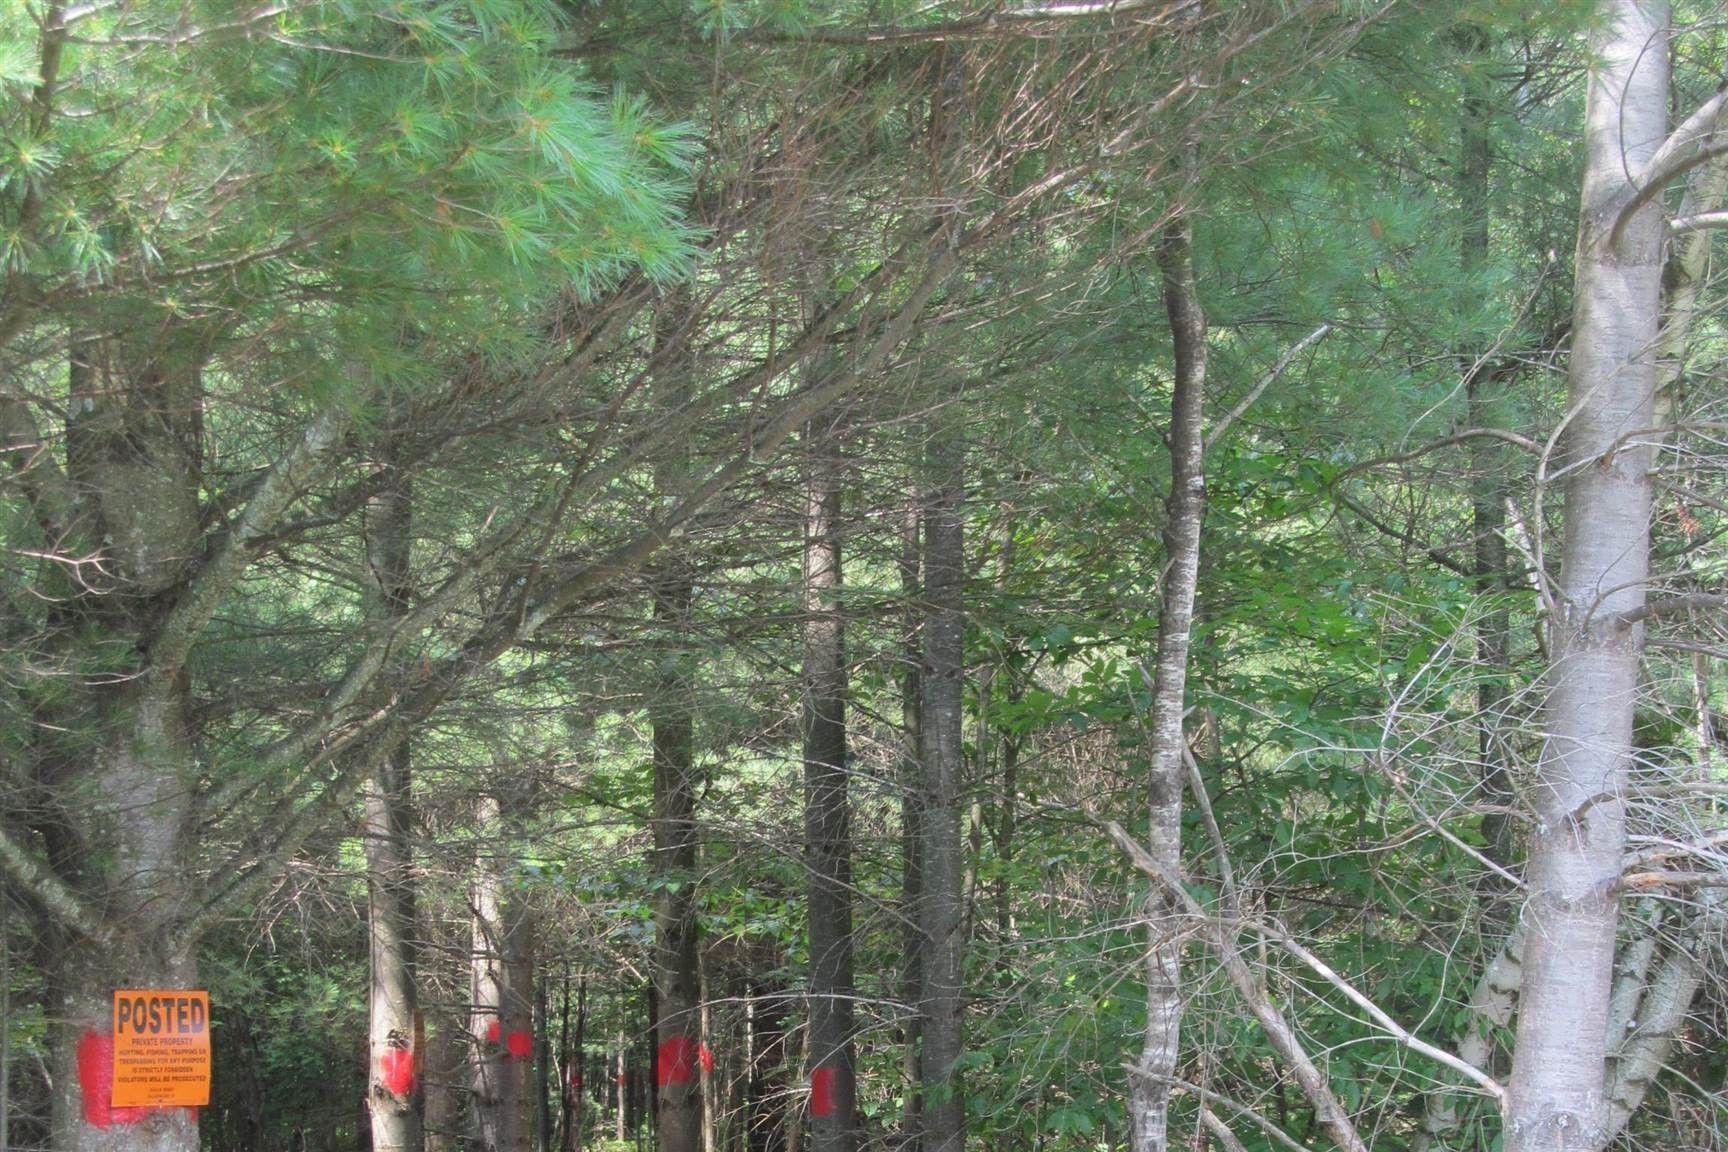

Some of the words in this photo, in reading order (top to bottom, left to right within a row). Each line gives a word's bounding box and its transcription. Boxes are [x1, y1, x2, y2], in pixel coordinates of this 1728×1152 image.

[118, 997, 205, 1034] POSTED
[132, 1038, 158, 1046] PRIVATE
[160, 1037, 193, 1045] PROPERTY
